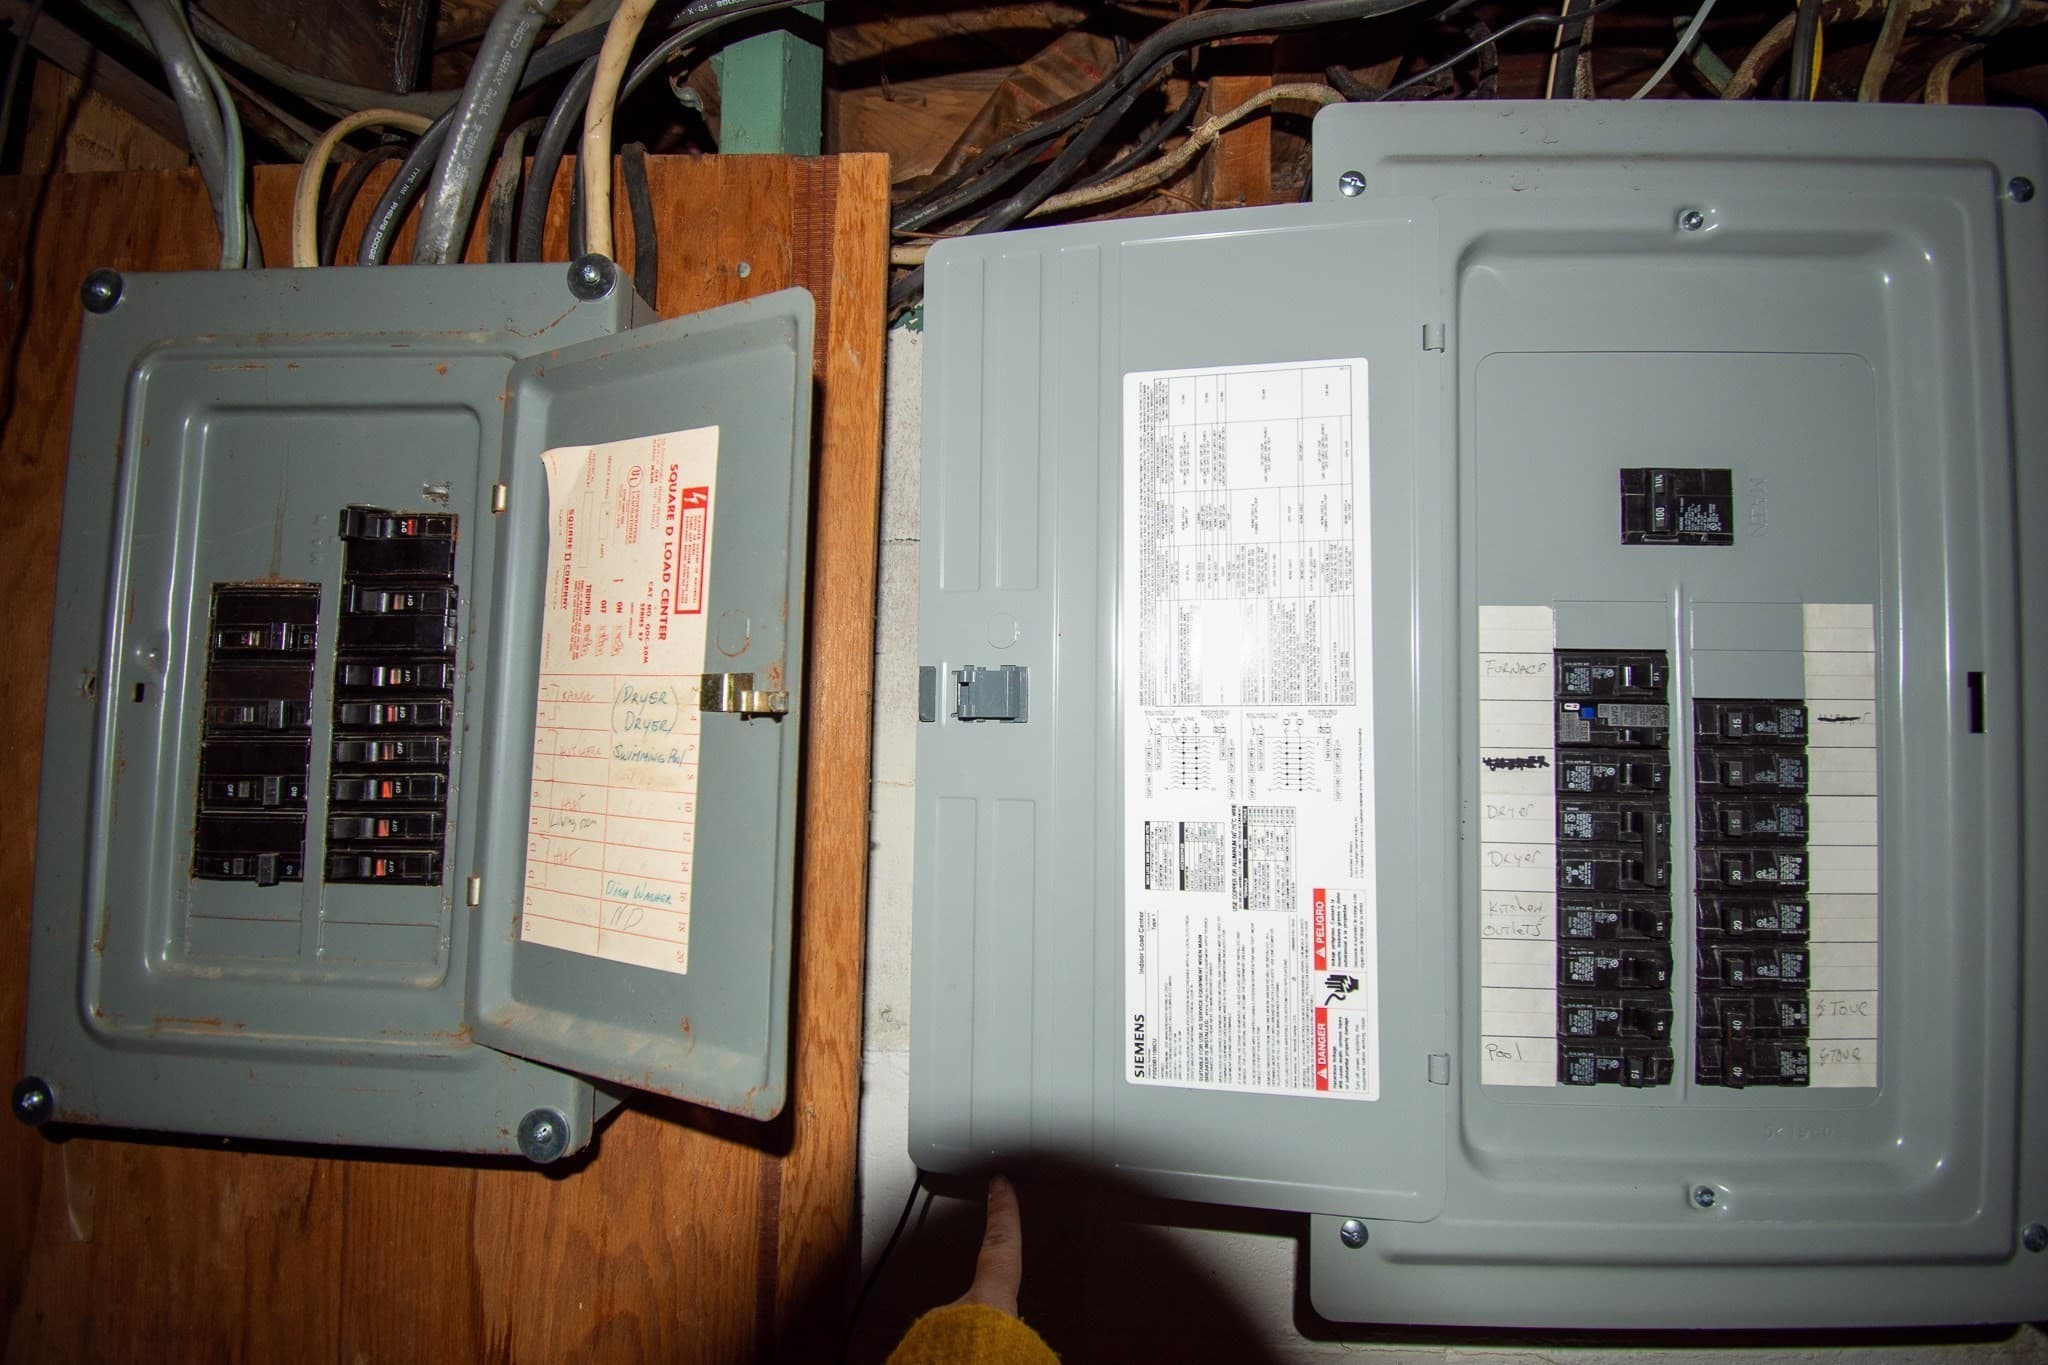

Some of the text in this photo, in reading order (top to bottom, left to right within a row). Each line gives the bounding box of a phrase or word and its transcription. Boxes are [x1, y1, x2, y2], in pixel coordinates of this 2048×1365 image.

[380, 201, 399, 231] PHELPS
[369, 231, 383, 261] DODGE
[1655, 507, 1665, 521] 100
[566, 508, 575, 549] SQUARE
[658, 464, 679, 641] SQUARE D LOAD CENTER
[562, 564, 571, 610] COMPANY
[584, 584, 592, 616] TRIPPED
[599, 600, 608, 613] OFF
[616, 601, 623, 614] ON
[1732, 718, 1743, 729] 15
[1731, 818, 1741, 829] 15
[1732, 870, 1741, 881] 20
[1315, 901, 1325, 945] PELIGRO
[1733, 920, 1743, 931] 20
[1733, 970, 1743, 981] 20
[1732, 1019, 1742, 1031] 40
[1134, 1013, 1145, 1079] SIEMENS
[1317, 1023, 1327, 1065] DANGER
[1631, 1070, 1641, 1079] 15
[1732, 1066, 1742, 1078] 40
